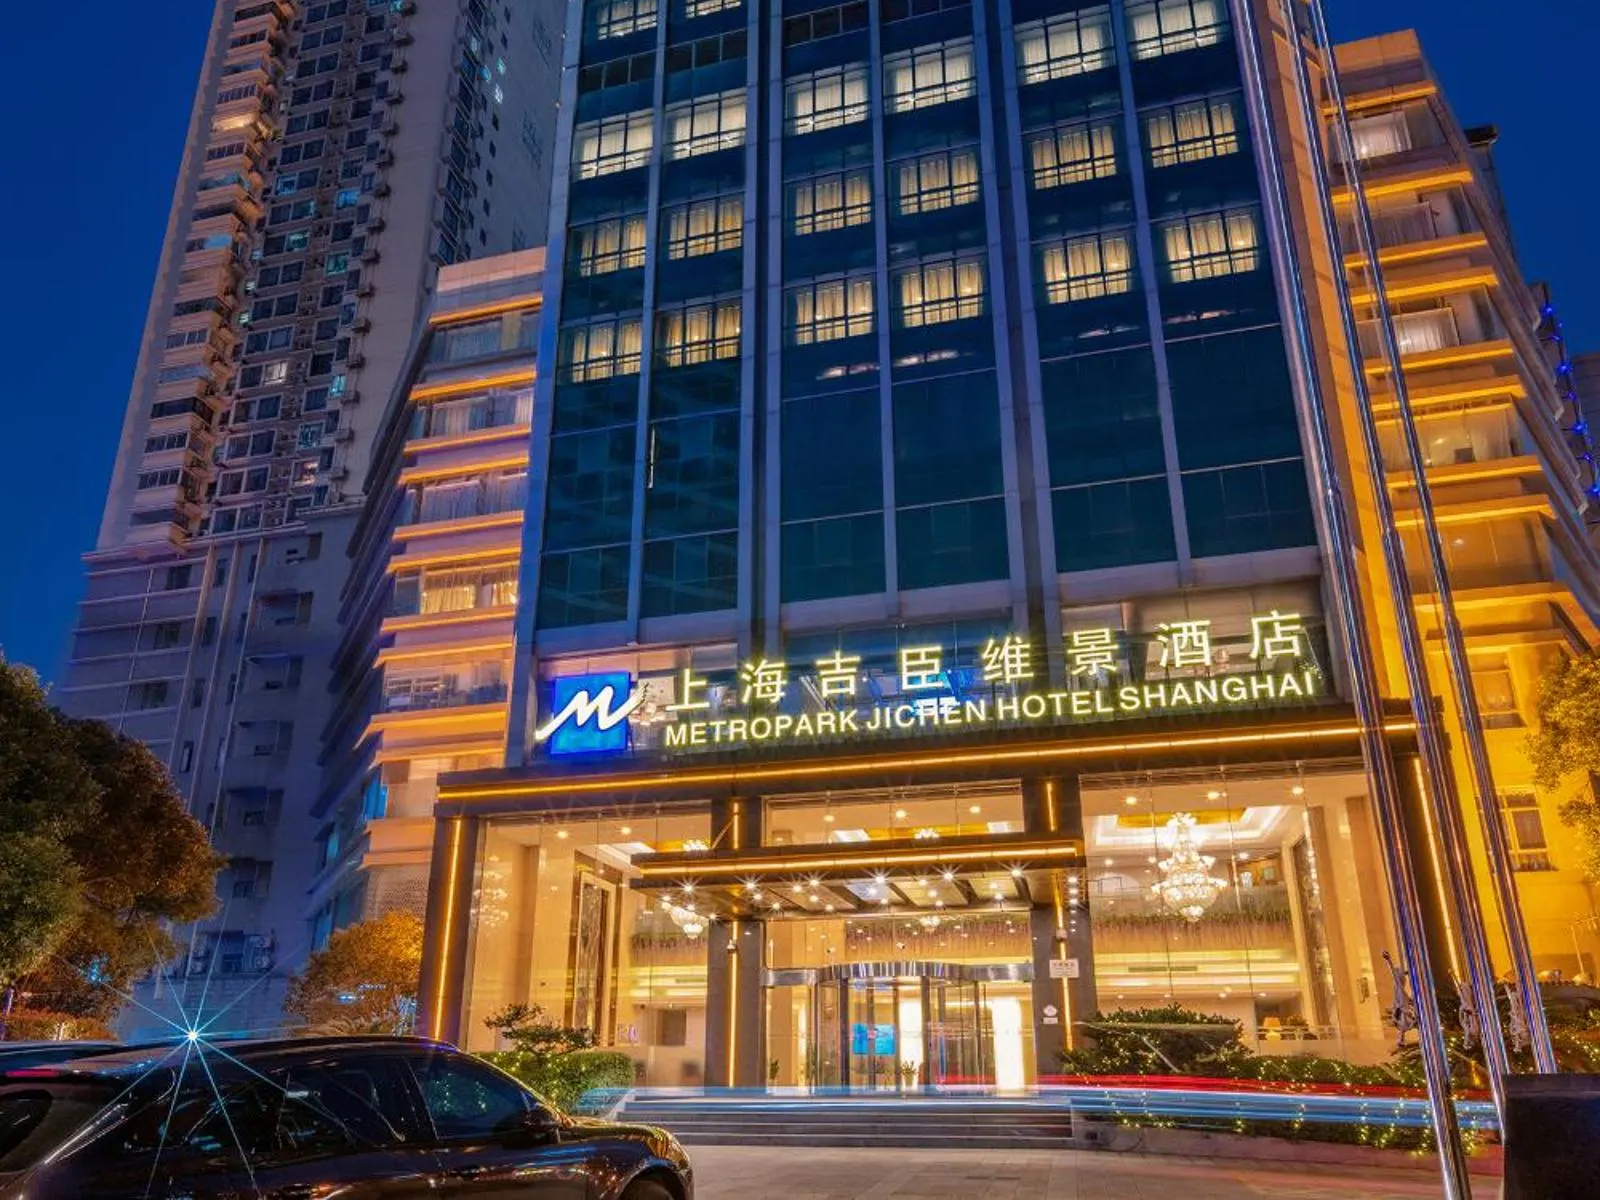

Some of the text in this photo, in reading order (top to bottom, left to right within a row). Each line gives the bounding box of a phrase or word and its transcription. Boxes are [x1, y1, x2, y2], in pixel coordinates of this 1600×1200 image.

[666, 610, 1303, 711] 上海吉臣维景酒店
[665, 671, 1315, 746] METROPARK JICHEN HOTEL SHANGHAI
